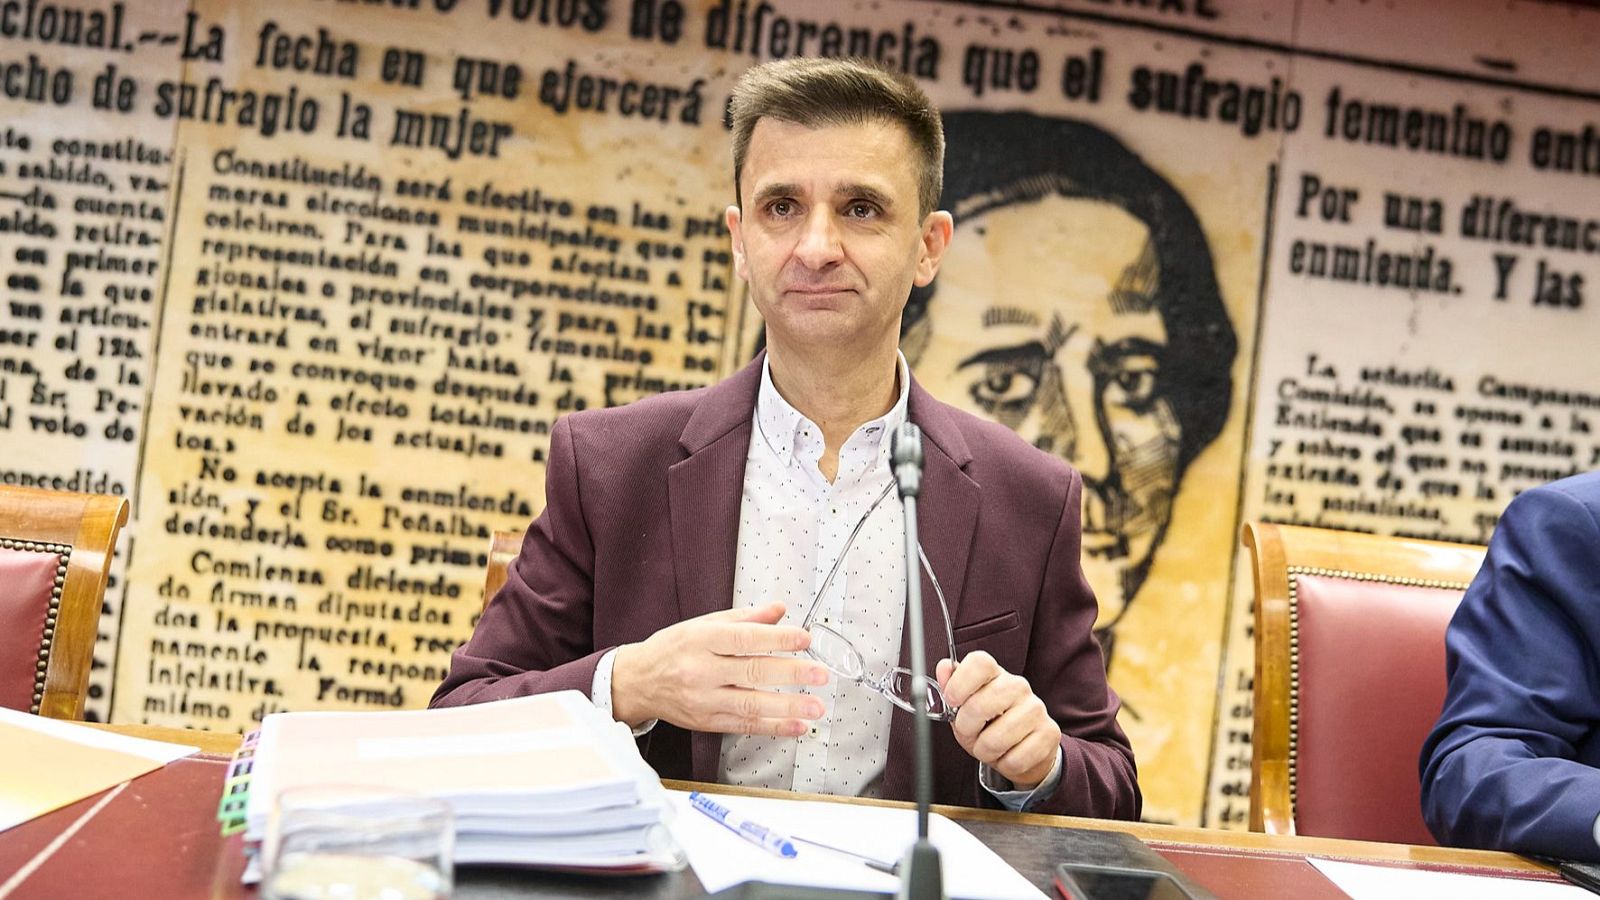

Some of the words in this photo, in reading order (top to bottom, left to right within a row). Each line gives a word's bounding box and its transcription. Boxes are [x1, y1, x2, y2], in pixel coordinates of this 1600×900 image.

[254, 21, 358, 78] fecha
[381, 46, 425, 86] en
[453, 56, 522, 99] que
[539, 59, 706, 126] ejercerá
[629, 0, 683, 43] de
[703, 0, 939, 81] diferencia
[963, 43, 1040, 96] que
[1063, 48, 1107, 102] el
[1127, 61, 1304, 138] sufragio
[1325, 86, 1513, 165] femenino
[1530, 122, 1600, 174] ent
[0, 54, 74, 105] cho
[93, 64, 137, 113] de
[154, 78, 320, 137] sufragio
[336, 93, 373, 140] la
[53, 138, 171, 165] constitu-
[19, 160, 114, 191] sabido,
[130, 175, 169, 191] va-
[213, 149, 382, 192] Constitución
[396, 178, 452, 200] será
[465, 183, 572, 216] efectivo
[587, 206, 618, 224] en
[632, 202, 670, 229] las
[75, 198, 164, 221] cuenta
[1295, 171, 1358, 223] Por
[1382, 191, 1443, 234] una
[75, 222, 161, 246] retira-
[209, 184, 288, 207] meras
[306, 191, 440, 225] elecciones
[458, 215, 620, 252] municipales
[637, 241, 684, 260] que
[15, 248, 46, 265] en
[66, 250, 158, 275] primer
[205, 209, 324, 239] celebren.
[344, 221, 407, 250] Para
[426, 233, 462, 257] las
[484, 248, 531, 267] que
[552, 253, 649, 282] afectan
[666, 271, 681, 286] a
[702, 269, 726, 291] la
[7, 274, 39, 291] en
[61, 273, 83, 296] la
[104, 284, 152, 304] que
[202, 239, 398, 277] representación
[419, 266, 449, 283] en
[469, 274, 657, 311] corporaciones
[687, 301, 723, 319] re-
[1289, 238, 1464, 295] enmienda.
[1492, 253, 1519, 300] Y
[1532, 259, 1585, 308] las
[9, 301, 41, 319] un
[196, 262, 306, 293] gionales
[322, 282, 335, 297] o
[351, 285, 513, 320] provinciales
[528, 309, 543, 328] y
[558, 312, 618, 333] para
[634, 314, 671, 340] las
[55, 330, 77, 351] el
[193, 294, 327, 327] gislativas,
[350, 310, 372, 330] el
[390, 314, 498, 347] sufragio
[529, 329, 653, 364] femenino
[684, 355, 716, 371] no
[190, 323, 288, 348] entrará
[309, 337, 338, 353] en
[357, 337, 427, 364] vigor
[449, 349, 518, 376] hasta
[550, 360, 573, 382] la
[1306, 354, 1337, 378] La
[0, 358, 40, 377] na,
[65, 359, 96, 381] de
[118, 363, 140, 385] la
[186, 351, 233, 378] que
[249, 358, 275, 372] se
[292, 361, 416, 392] convoque
[432, 374, 538, 405] después
[556, 389, 587, 410] de
[30, 382, 66, 409] Sr.
[95, 389, 139, 413] Pe-
[182, 370, 278, 402] llevado
[296, 392, 309, 406] a
[331, 392, 409, 418] efecto
[430, 405, 548, 434] totalmen
[1278, 378, 1396, 414] Comisión,
[1414, 402, 1436, 415] se
[1541, 416, 1553, 428] a
[1570, 414, 1591, 433] la
[29, 416, 87, 437] voto
[105, 419, 134, 441] de
[180, 403, 263, 430] vación
[286, 413, 316, 435] de
[1401, 427, 1441, 444] que
[1269, 442, 1283, 456] y
[1297, 438, 1361, 460] sobre
[1375, 446, 1396, 463] el
[1407, 455, 1447, 473] que
[0, 471, 125, 495] oncedido
[198, 456, 237, 482] No
[256, 470, 342, 497] acepta
[359, 473, 382, 498] la
[401, 485, 532, 516] enmienda
[1420, 482, 1460, 497] que
[1475, 480, 1494, 500] la
[169, 483, 228, 514] sión,
[245, 499, 260, 519] y
[280, 496, 300, 519] el
[322, 500, 358, 525] Sr.
[326, 536, 394, 557] como
[191, 551, 323, 586] Comienza
[347, 566, 461, 598] diciendo
[158, 576, 190, 598] do
[318, 593, 451, 625] diputados
[154, 605, 199, 628] dos
[216, 610, 239, 632] la
[254, 621, 396, 653] propuesta,
[151, 639, 268, 664] namente
[298, 645, 321, 671] la
[148, 659, 284, 696] iniciativa.
[143, 694, 231, 719] mismo
